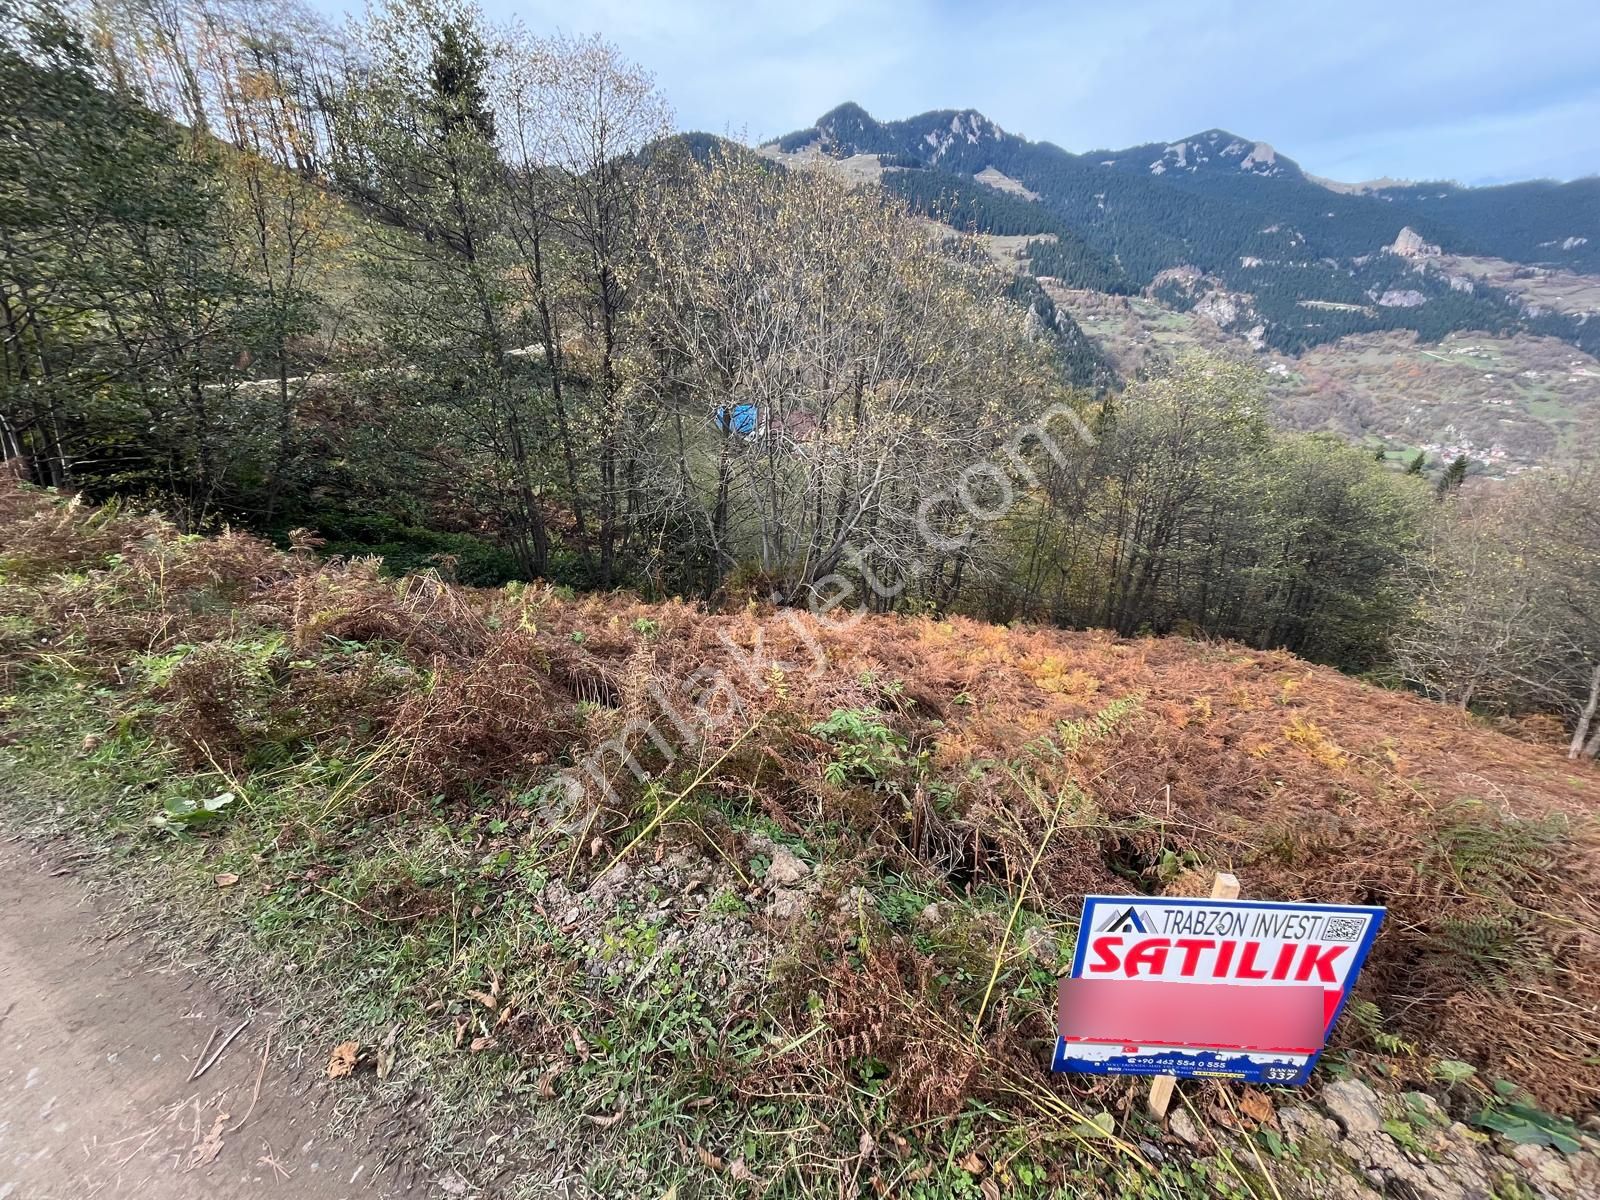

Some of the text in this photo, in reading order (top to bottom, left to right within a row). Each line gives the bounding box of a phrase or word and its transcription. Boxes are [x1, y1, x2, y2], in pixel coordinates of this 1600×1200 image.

[1163, 909, 1249, 936] TRABZON
[1088, 936, 1349, 983] SATILIK
[1206, 1061, 1226, 1069] 555
[1267, 1072, 1295, 1080] 337
